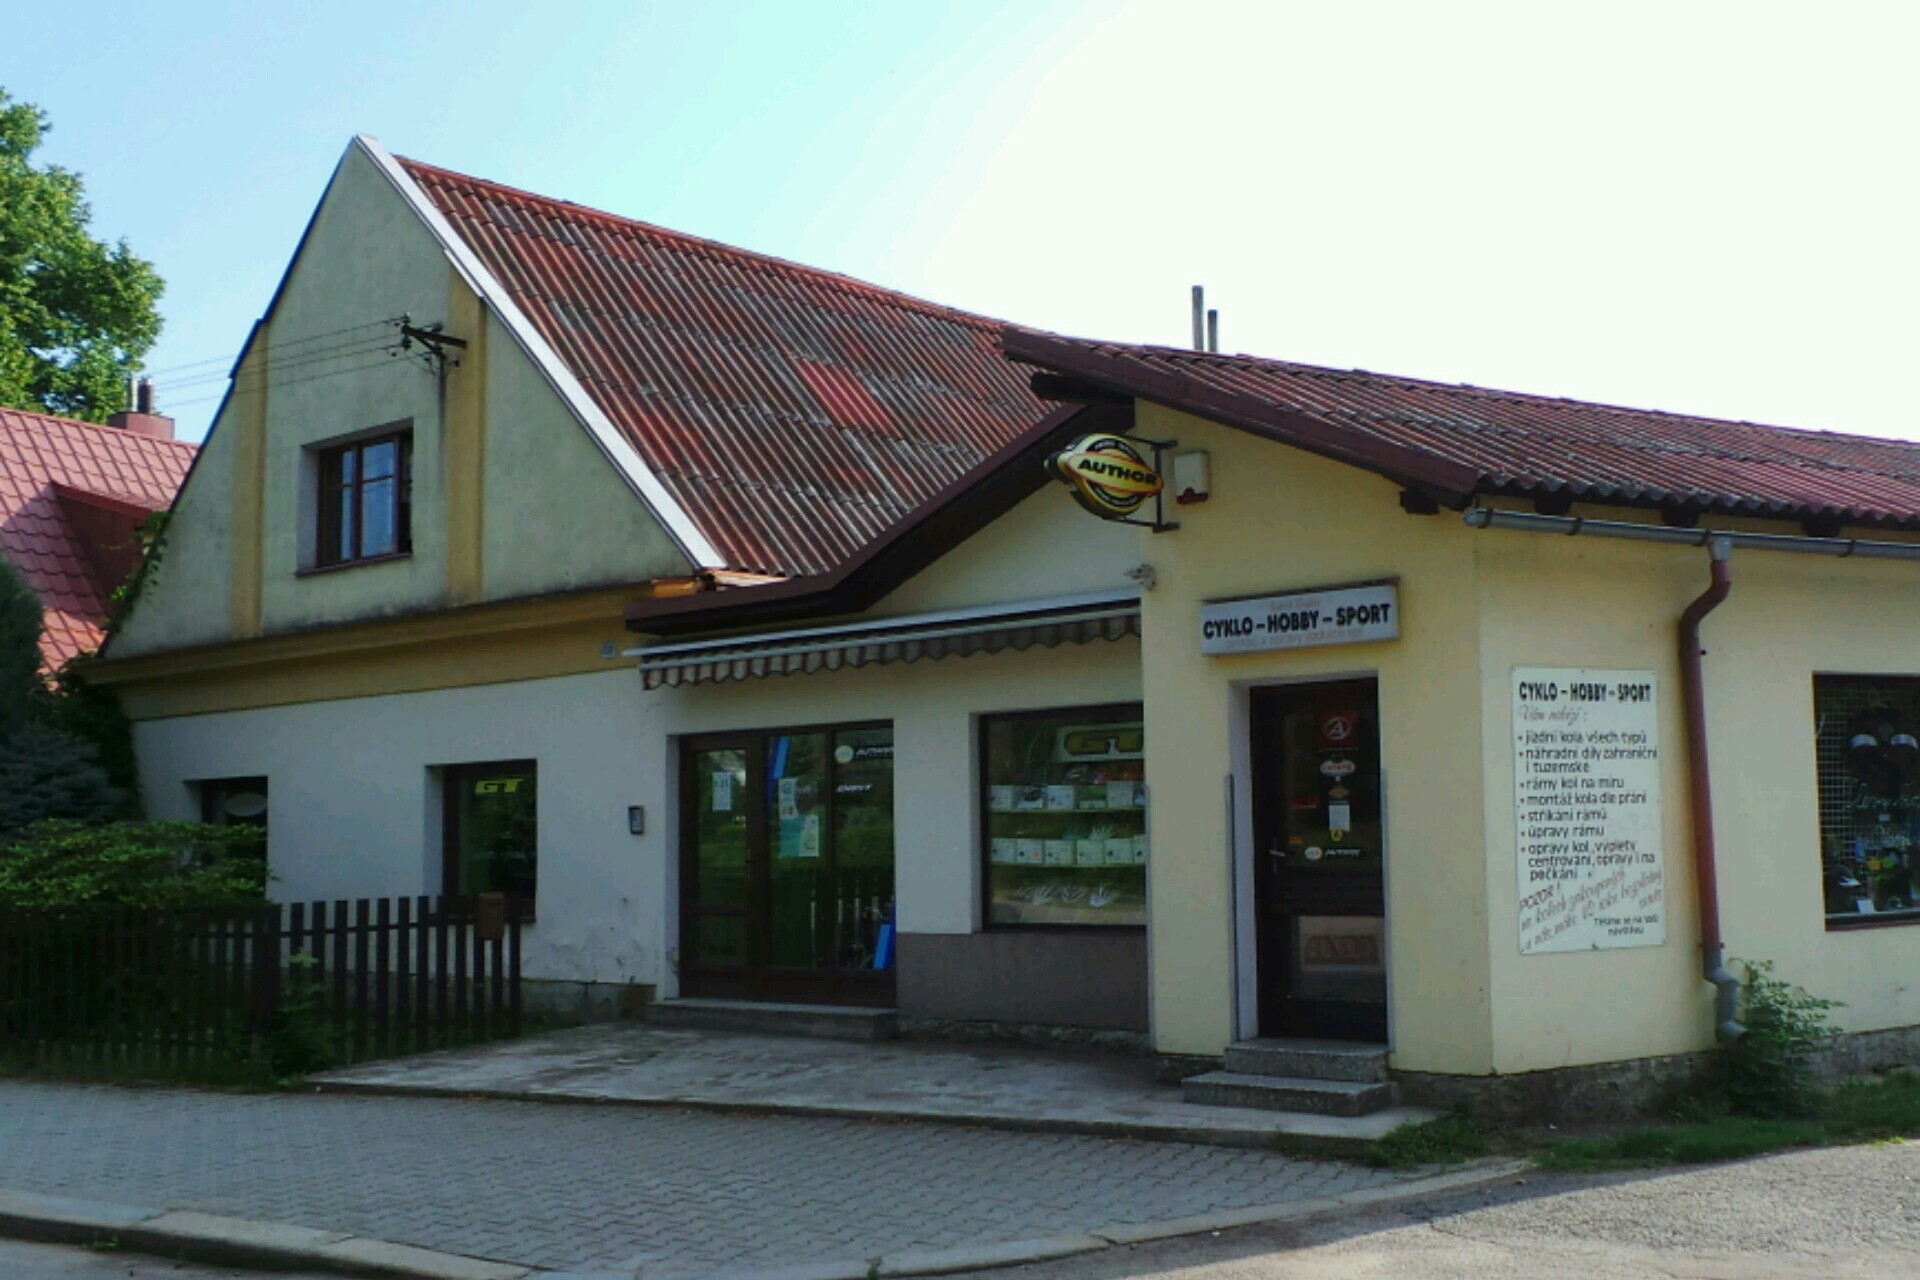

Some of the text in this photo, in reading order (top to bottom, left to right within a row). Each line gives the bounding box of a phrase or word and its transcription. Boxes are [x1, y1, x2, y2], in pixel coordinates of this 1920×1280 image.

[1077, 457, 1156, 485] AUTHOR
[1203, 616, 1253, 640] CYKLO
[1267, 610, 1319, 633] HOBBY
[1336, 604, 1391, 627] SPORT
[1519, 681, 1558, 701] CYKLO
[1570, 682, 1607, 702] HOBBY
[1618, 683, 1651, 703] SPORT
[475, 778, 524, 795] GT
[1561, 776, 1578, 789] kol
[1581, 778, 1596, 788] na
